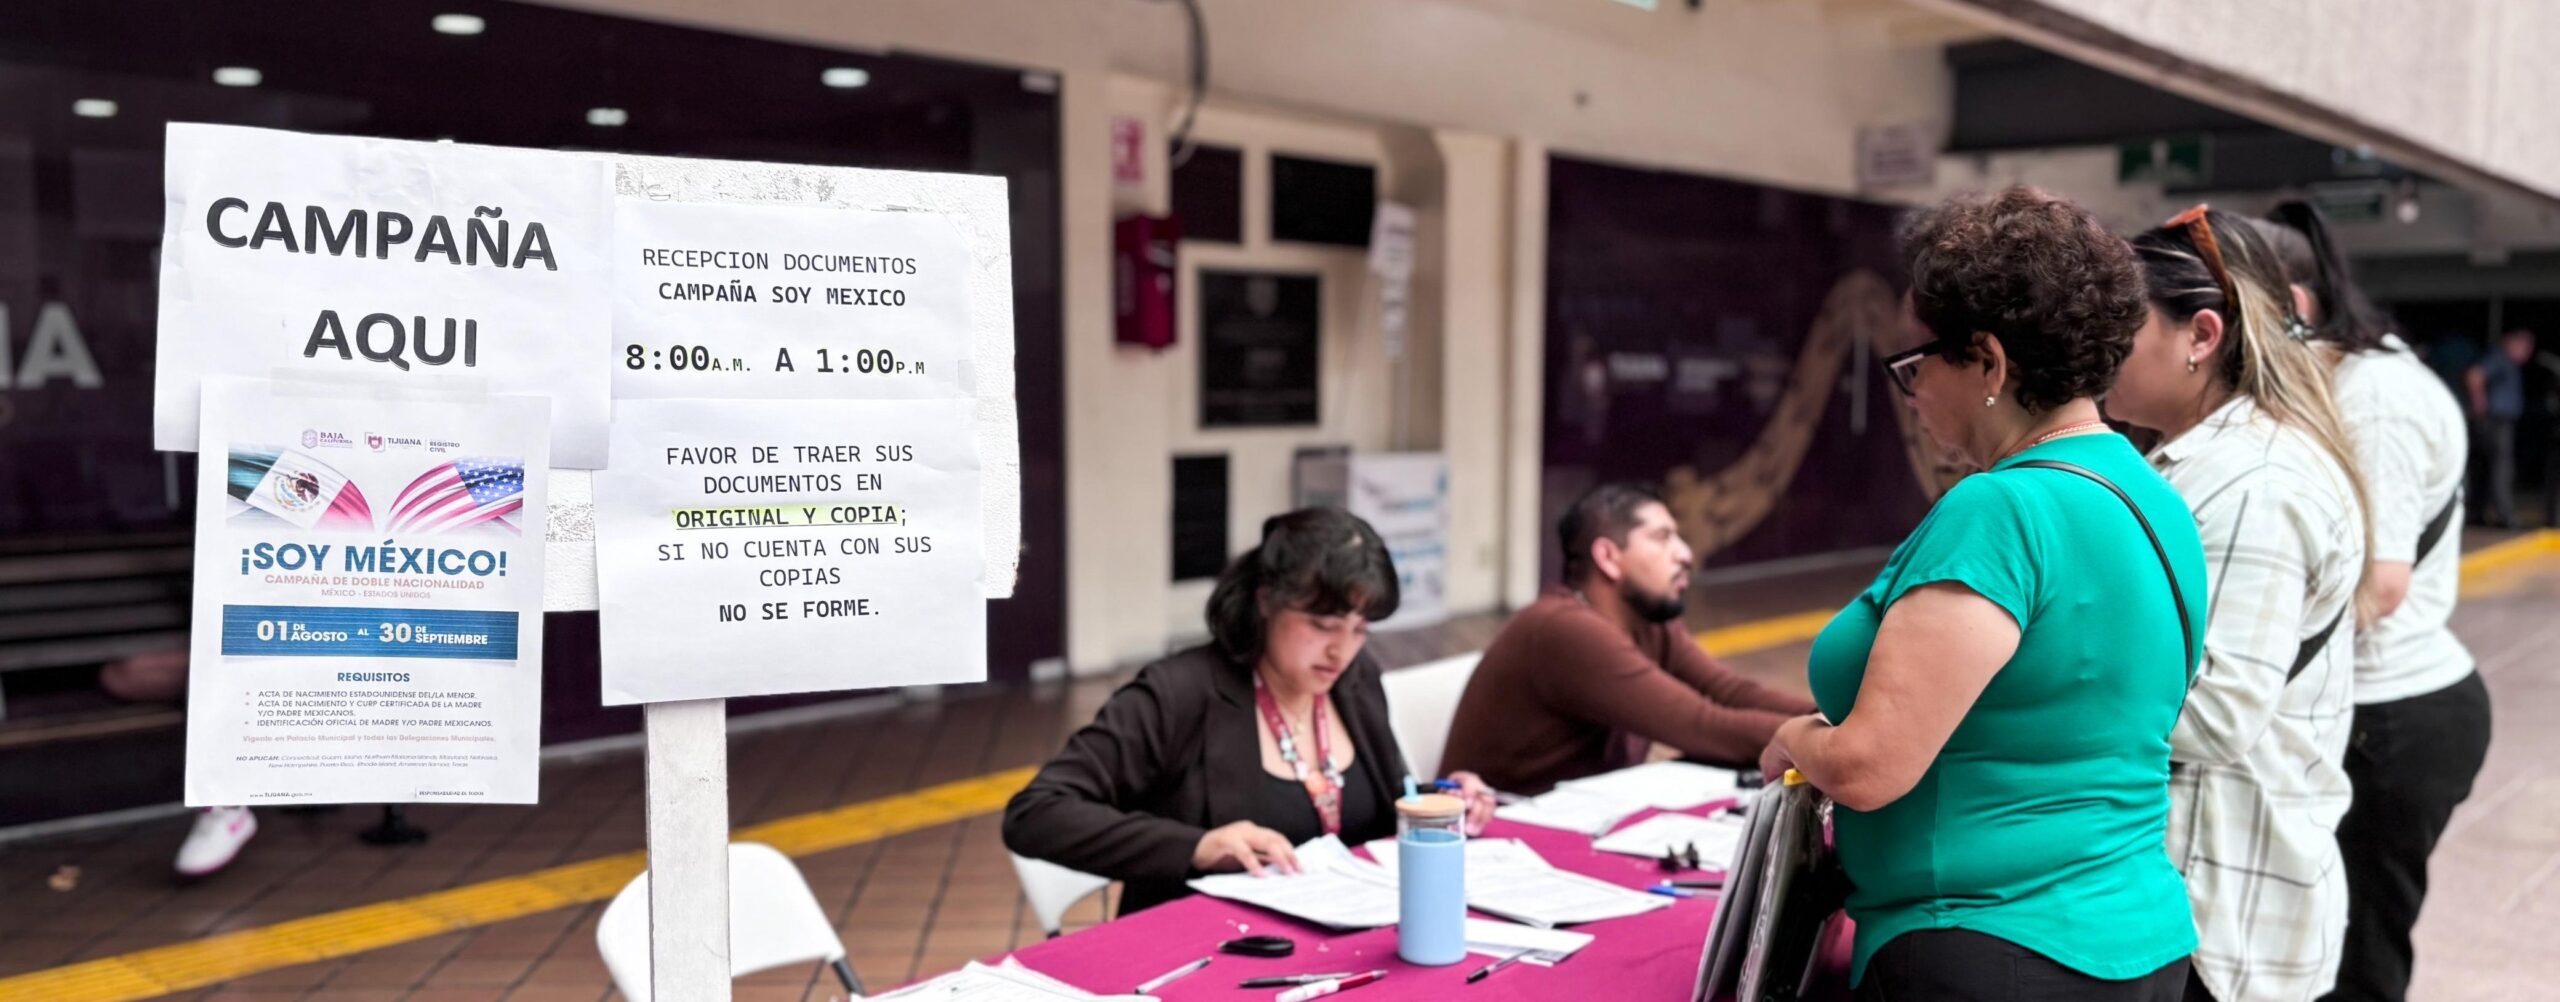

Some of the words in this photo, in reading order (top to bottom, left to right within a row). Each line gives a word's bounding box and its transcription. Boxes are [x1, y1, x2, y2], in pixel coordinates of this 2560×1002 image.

[205, 196, 558, 272] CAMPAÑA
[642, 249, 770, 271] RECEPCION
[783, 253, 917, 276] DOCUMENTOS
[658, 278, 757, 304] CAMPAÑA
[771, 285, 811, 304] SOY
[825, 286, 906, 307] MEXICO
[302, 308, 479, 372] AQUI
[774, 346, 795, 373] A
[320, 431, 344, 440] BAJA
[388, 437, 422, 446] TIJUANA
[429, 446, 447, 454] CIVIL
[665, 446, 738, 466] FAVOR
[751, 445, 779, 464] DE
[793, 445, 861, 464] TRAER
[874, 443, 914, 463] SUS
[703, 474, 843, 495] DOCUMENTOS
[856, 473, 883, 492] EN
[675, 506, 790, 529] ORIGINAL
[802, 506, 817, 525] Y
[829, 504, 908, 527] COPIA;
[657, 542, 686, 562] SI
[700, 540, 730, 560] NO
[742, 538, 827, 559] CUENTA
[839, 536, 881, 557] CON
[893, 535, 932, 555] SUS
[241, 541, 332, 576] ¡SOY
[345, 538, 507, 577] MÉXICO!
[264, 573, 329, 587] CAMPAÑA
[333, 576, 348, 587] DE
[351, 577, 390, 588] DOBLE
[393, 578, 485, 590] NACIONALIDAD
[758, 566, 842, 588] COPIAS
[321, 587, 356, 597] MÉXICO
[363, 590, 399, 599] ESTADOS
[400, 591, 431, 600] UNIDOS
[718, 603, 747, 623] NO
[761, 600, 789, 621] SE
[802, 597, 881, 620] FORME.
[256, 619, 288, 642] 01
[293, 623, 306, 632] DE
[357, 628, 369, 636] AL
[378, 622, 412, 644] 30
[415, 625, 427, 634] DE
[290, 630, 348, 642] AGOSTO
[415, 632, 488, 646] SEPTIEMBRE
[337, 672, 411, 683] REQUISITOS
[258, 690, 281, 698] ACTA
[283, 690, 293, 698] DE
[295, 690, 348, 698] NACIMIENTO
[349, 690, 417, 699] ESTADOUNIDENSE
[418, 691, 445, 699] DEL/LA
[446, 692, 477, 700] MENOR.
[257, 700, 281, 708] ACTA
[282, 700, 293, 708] DE
[295, 700, 348, 708] NACIMIENTO
[349, 700, 355, 708] Y
[356, 700, 378, 708] CURP
[379, 700, 430, 709] CERTIFICADA
[431, 701, 442, 709] DE
[443, 701, 454, 709] LA
[454, 701, 483, 710] MADRE
[257, 709, 275, 718] Y/O
[276, 709, 302, 718] PADRE
[304, 709, 356, 718] MEXICANOS.
[257, 718, 324, 727] IDENTIFICACIÓN
[325, 719, 358, 727] OFICIAL
[359, 719, 369, 727] DE
[371, 719, 400, 727] MADRE
[401, 719, 417, 728] Y/O
[418, 719, 443, 728] PADRE
[286, 734, 317, 742] Palacio
[318, 734, 355, 743] Municipal
[399, 734, 450, 743] Delegaciones
